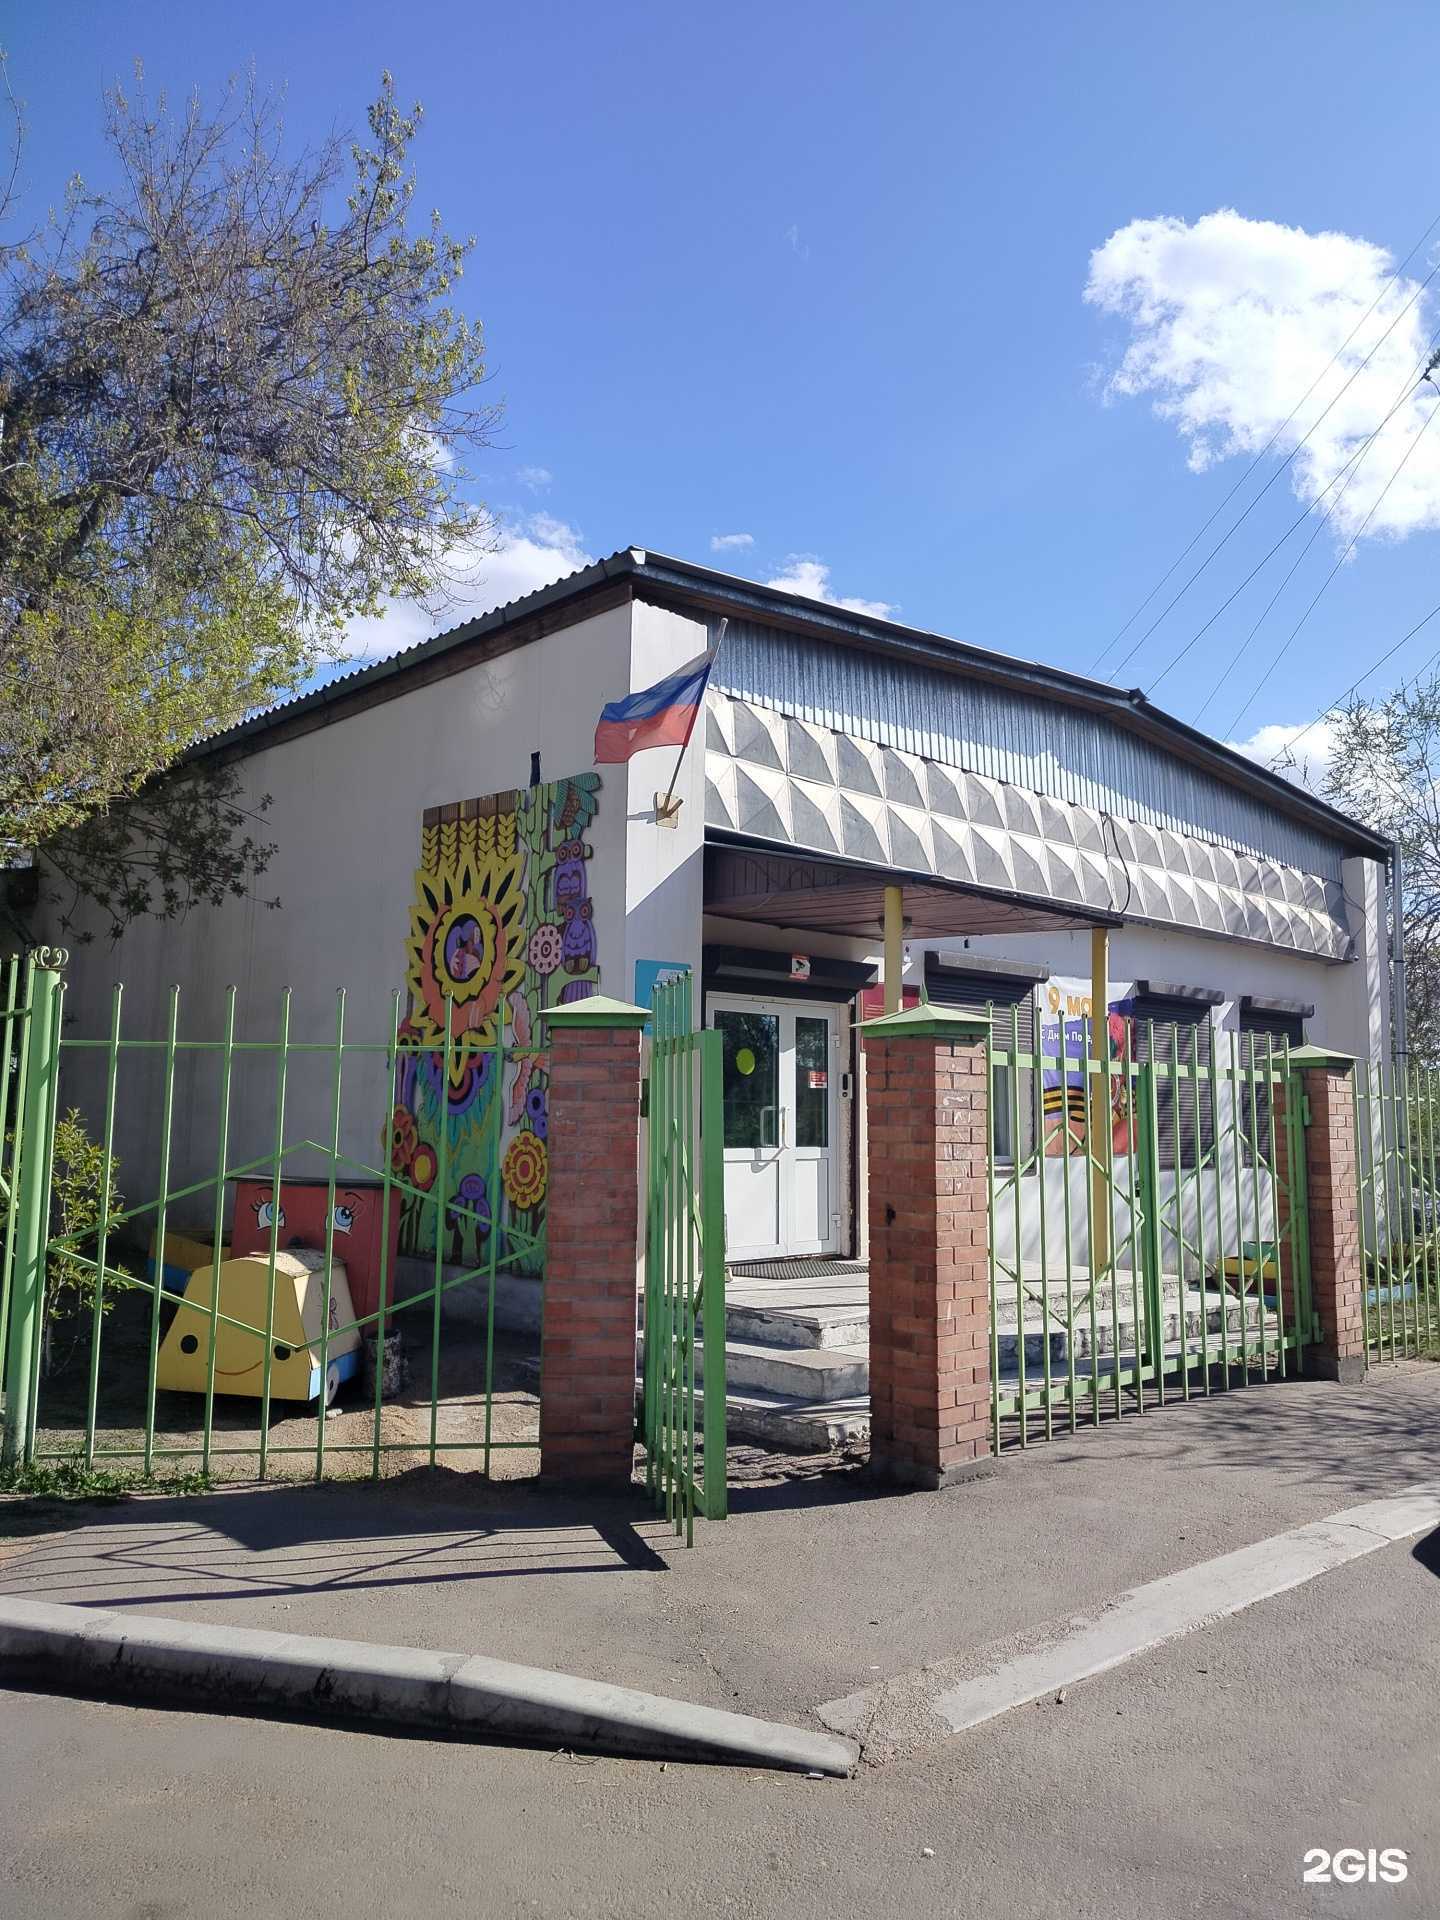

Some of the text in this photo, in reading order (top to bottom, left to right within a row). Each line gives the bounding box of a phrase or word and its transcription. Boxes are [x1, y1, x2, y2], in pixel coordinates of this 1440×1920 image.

[1048, 986, 1093, 1018] 9 ма
[1047, 1029, 1070, 1041] Днм
